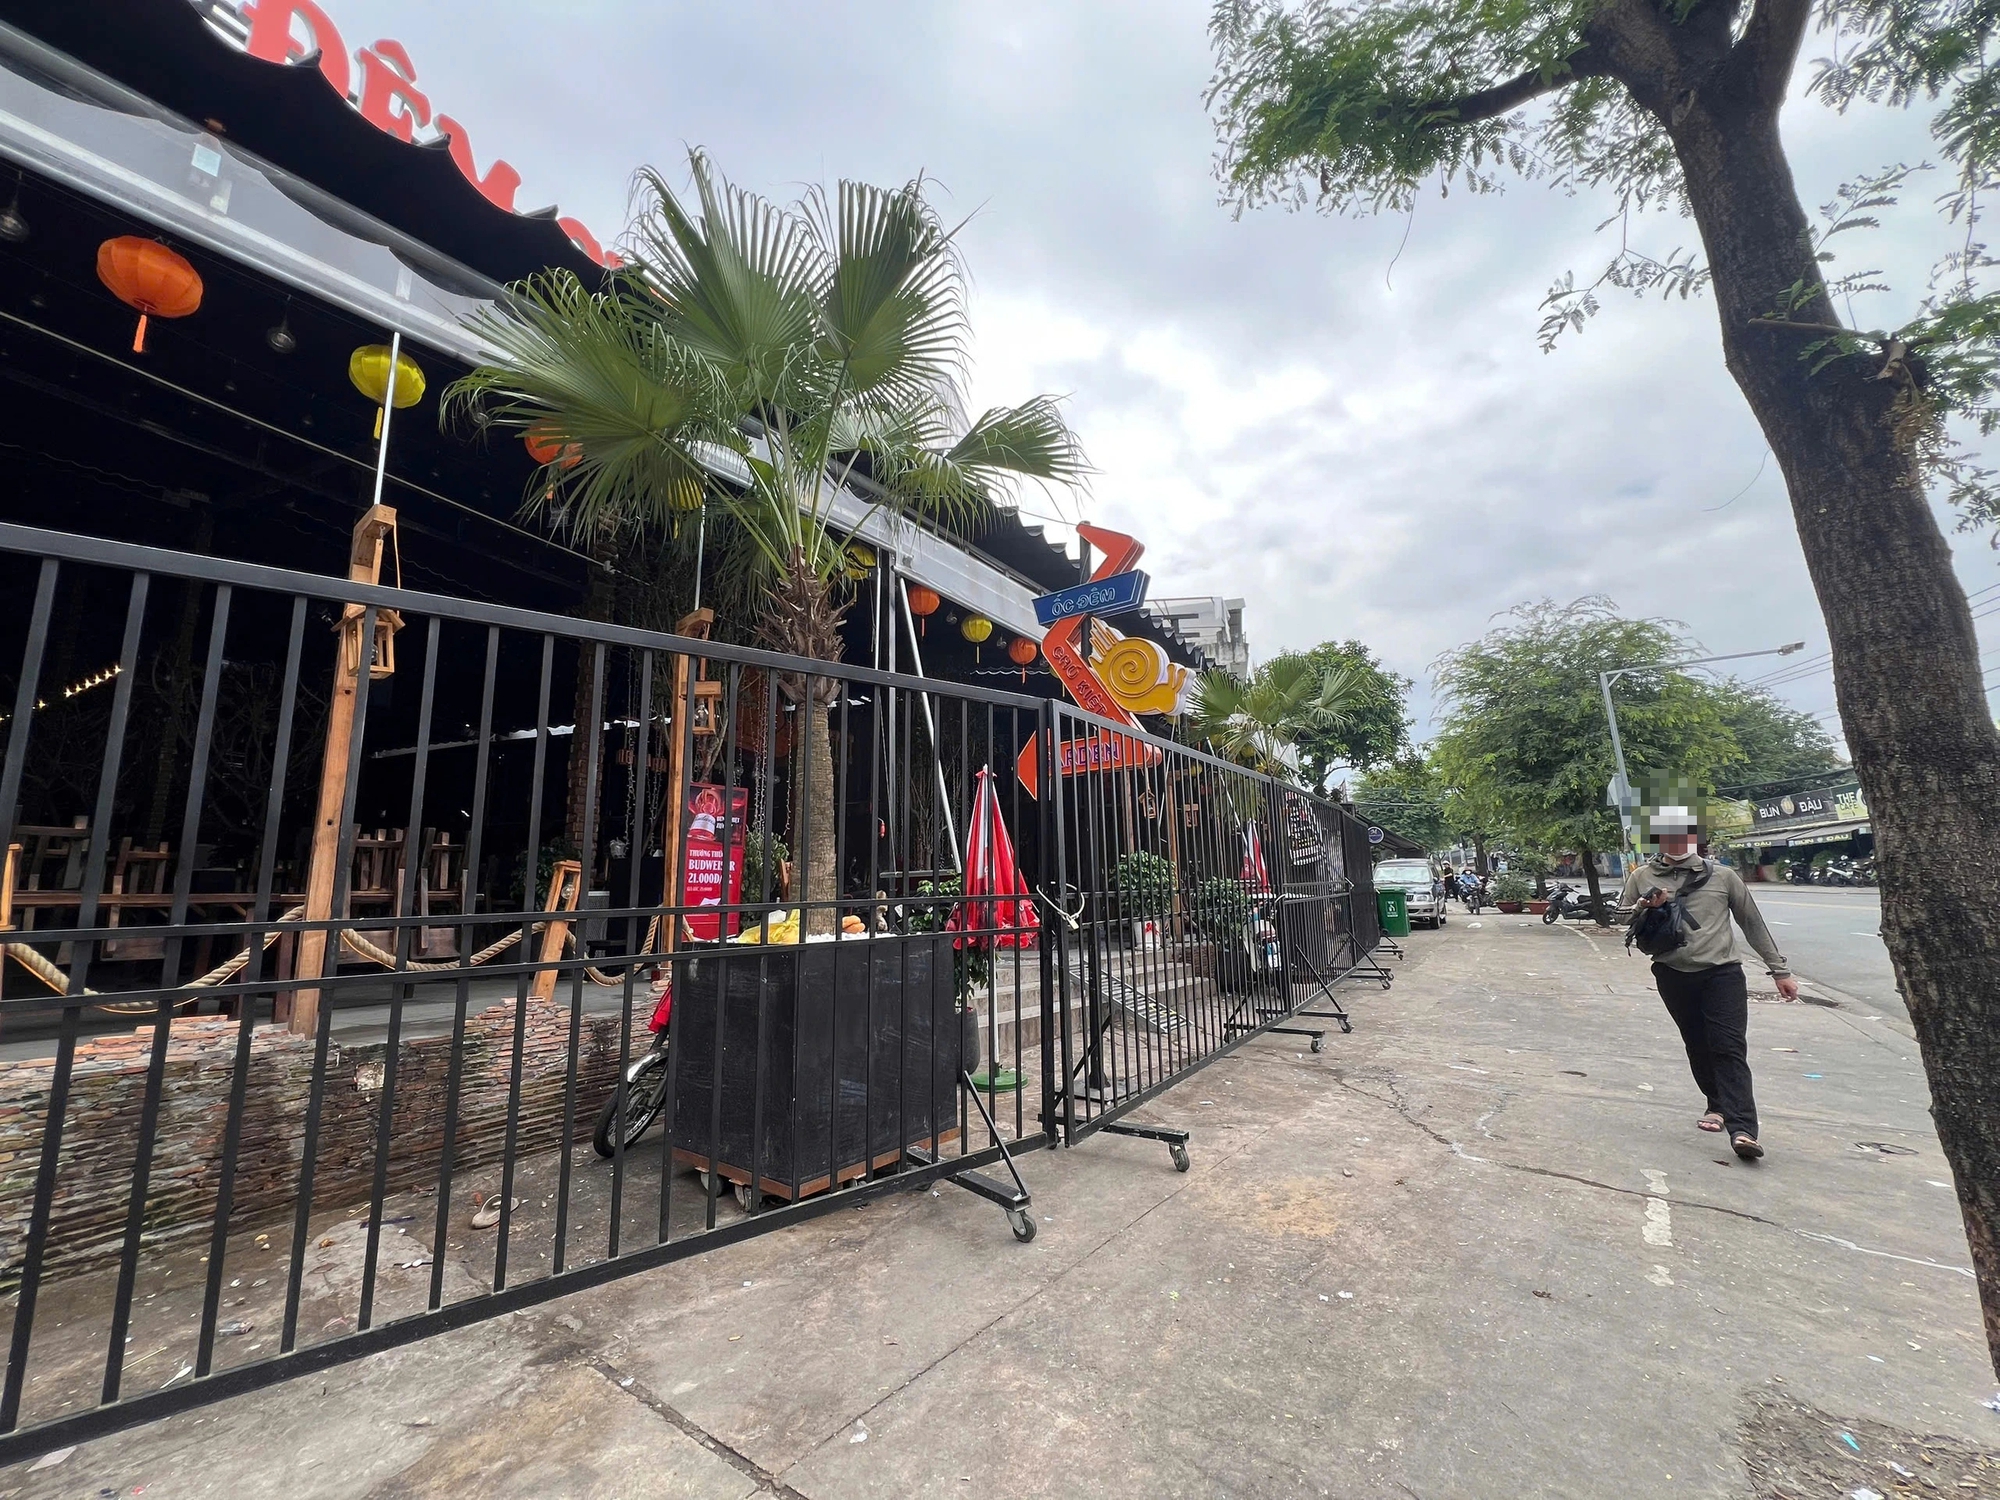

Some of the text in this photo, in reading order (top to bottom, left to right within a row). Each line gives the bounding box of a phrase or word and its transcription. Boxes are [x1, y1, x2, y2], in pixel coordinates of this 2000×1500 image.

[1052, 586, 1116, 616] ỐC ĐÊM
[1052, 646, 1082, 679] CHÚ
[1759, 797, 1822, 818] BÚN ĐẬU
[1836, 791, 1856, 804] THE
[688, 859, 736, 871] BUDWEIR
